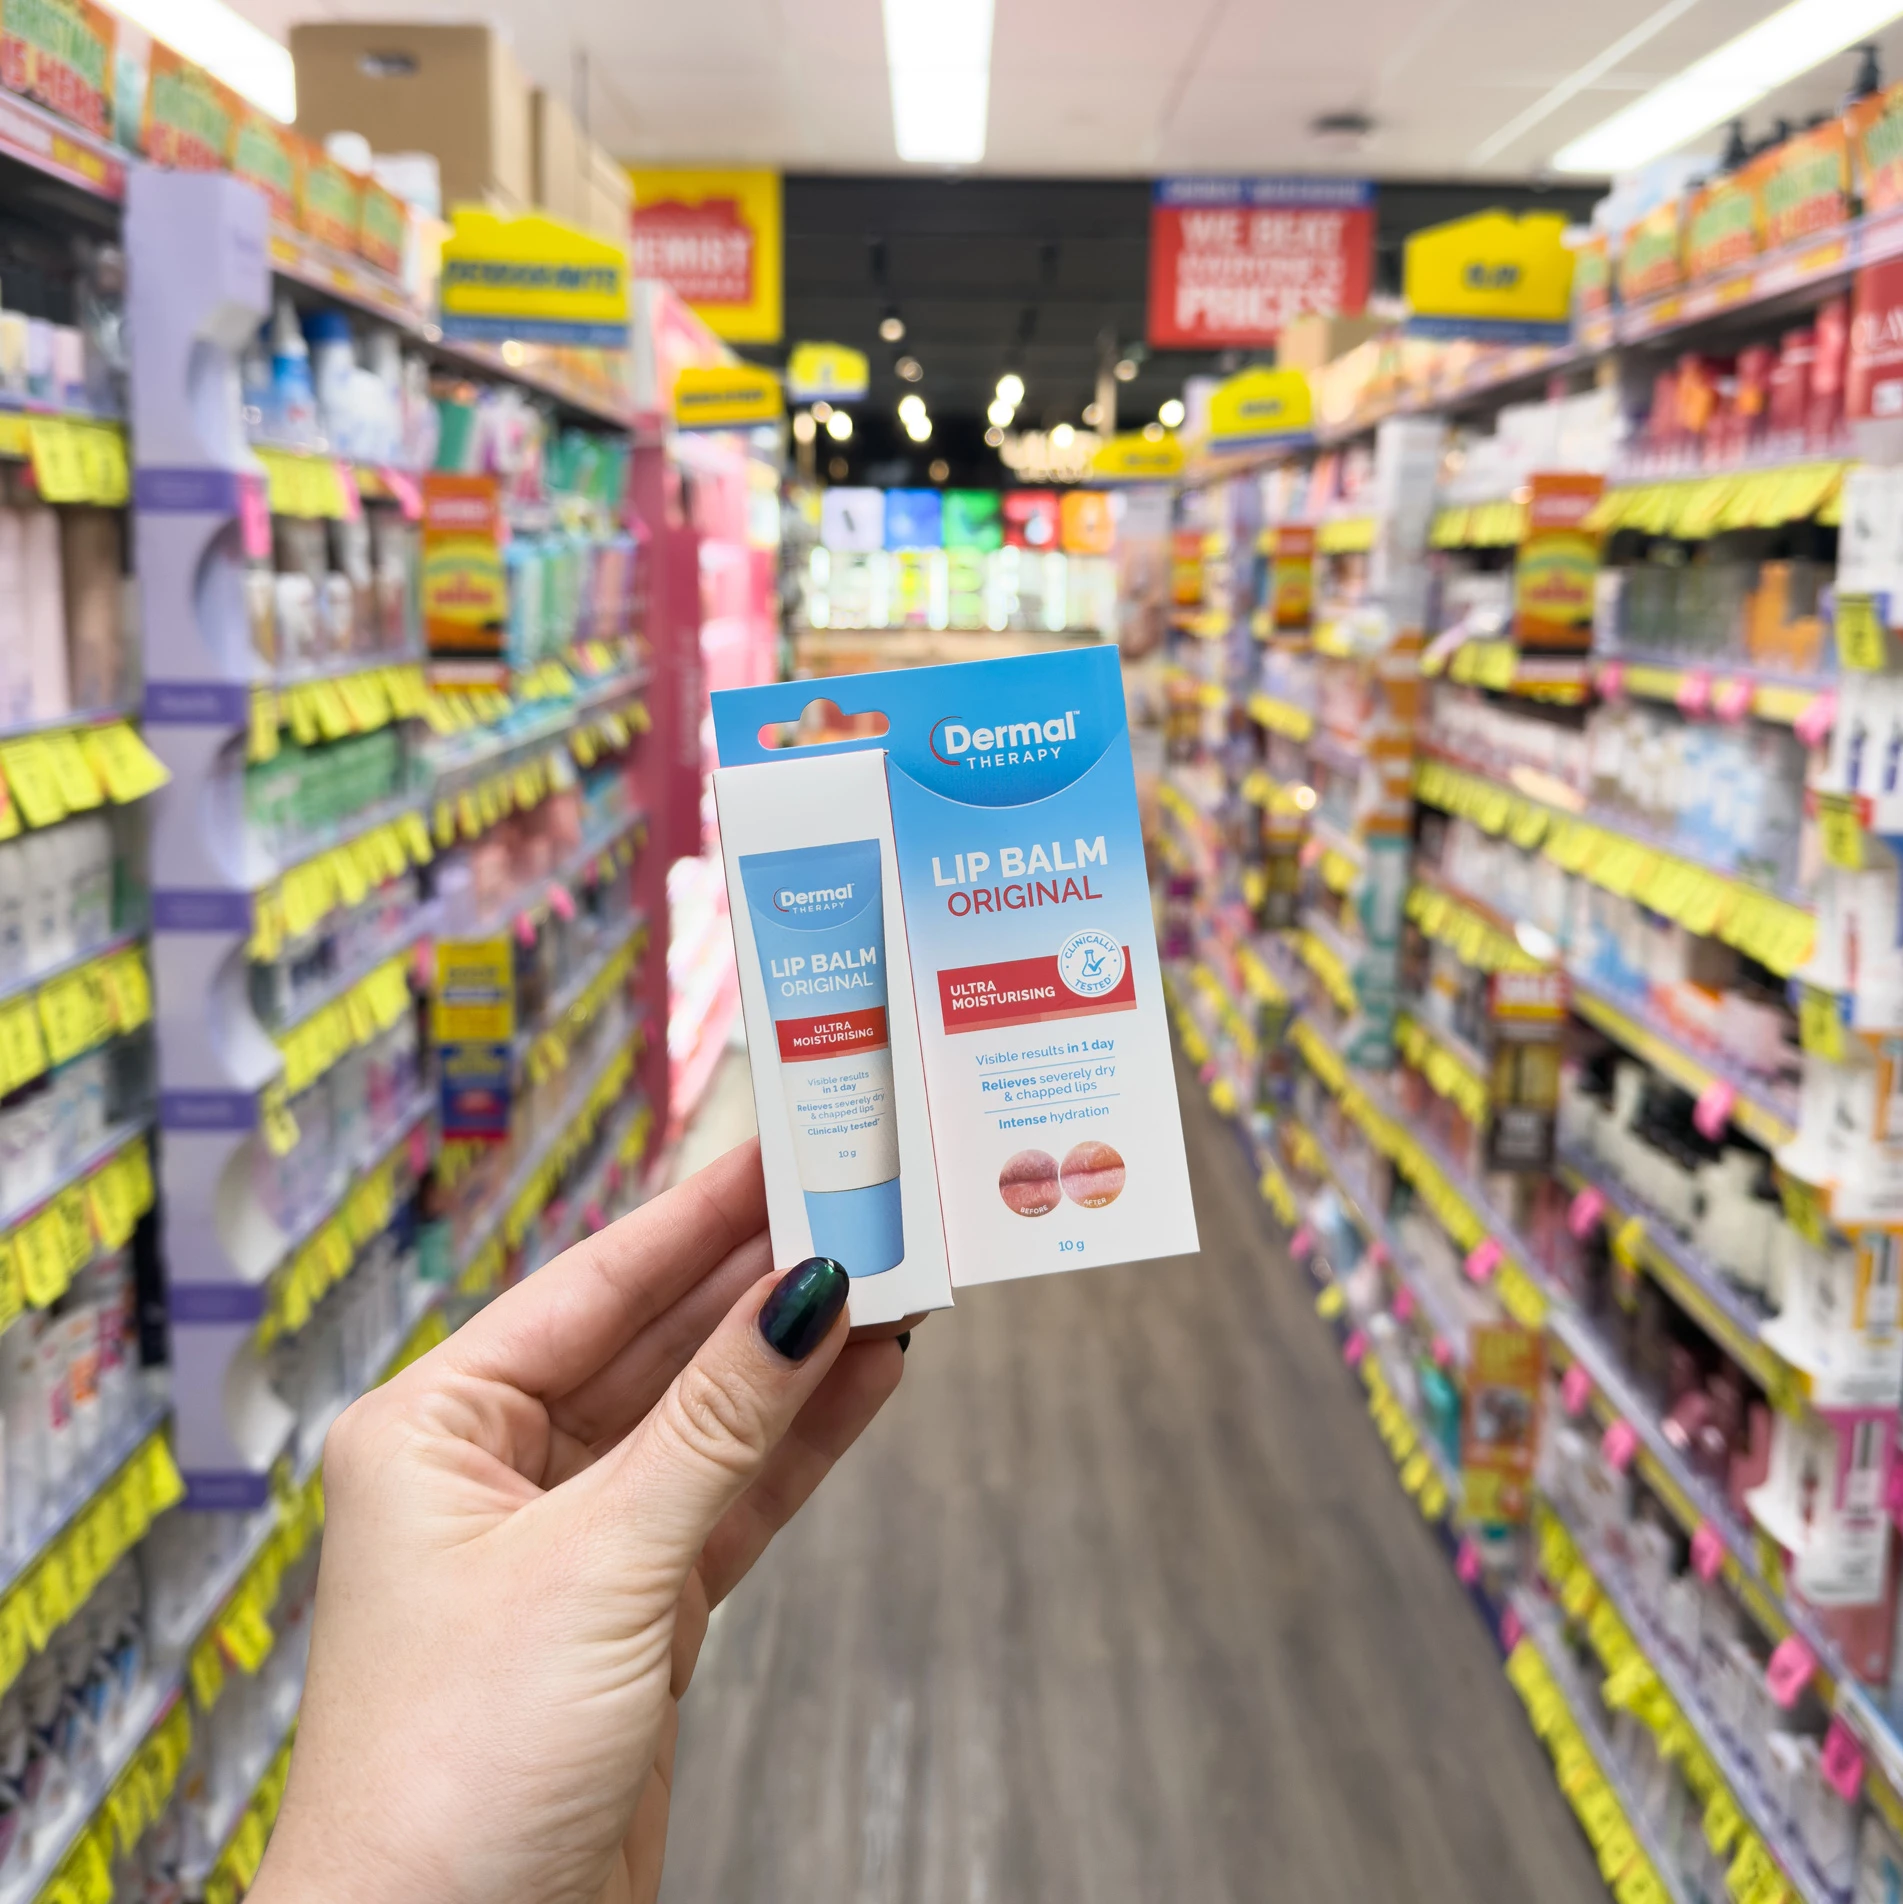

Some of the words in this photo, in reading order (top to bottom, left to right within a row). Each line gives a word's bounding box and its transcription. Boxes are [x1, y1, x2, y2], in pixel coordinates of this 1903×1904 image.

[966, 747, 1061, 769] THERAPY
[931, 851, 990, 887] LIP
[999, 836, 1108, 878] BALM
[947, 875, 1103, 917] ORIGINAL
[792, 901, 845, 914] THERAPY
[1065, 935, 1116, 959] CLINICALLY
[770, 956, 805, 978] LIP
[811, 946, 876, 974] BALM
[781, 971, 874, 997] ORIGINAL
[950, 980, 996, 997] ULTRA
[951, 986, 1056, 1011] MOISTURISING
[793, 1027, 874, 1047] MOISTURISING
[813, 1021, 851, 1034] ULTRA
[975, 1051, 1018, 1066] Visible
[1021, 1045, 1064, 1060] results
[1067, 1043, 1079, 1054] in
[1081, 1041, 1089, 1052] 1
[1091, 1039, 1115, 1052] day
[807, 1077, 838, 1086] Visible
[839, 1071, 869, 1082] results
[822, 1086, 831, 1094] in
[840, 1083, 856, 1091] day
[981, 1076, 1037, 1092] Relieves
[1039, 1067, 1092, 1084] severely
[1095, 1065, 1116, 1077] dry
[1004, 1091, 1013, 1102] &
[1016, 1083, 1072, 1100] chapped
[1074, 1081, 1097, 1094] lips
[797, 1103, 833, 1112] Relieves
[834, 1096, 871, 1108] severely
[872, 1092, 885, 1102] dry
[810, 1112, 817, 1120] &
[818, 1107, 858, 1119] chapped
[859, 1104, 874, 1114] lips
[998, 1113, 1047, 1130] Intense
[1049, 1105, 1109, 1124] hydration
[807, 1124, 848, 1136] Clinically
[838, 1150, 849, 1158] 10
[850, 1150, 857, 1158] g
[1020, 1204, 1049, 1215] BEFORE
[1083, 1197, 1107, 1206] AFTER
[1058, 1240, 1073, 1252] 10
[1076, 1240, 1085, 1252] g
